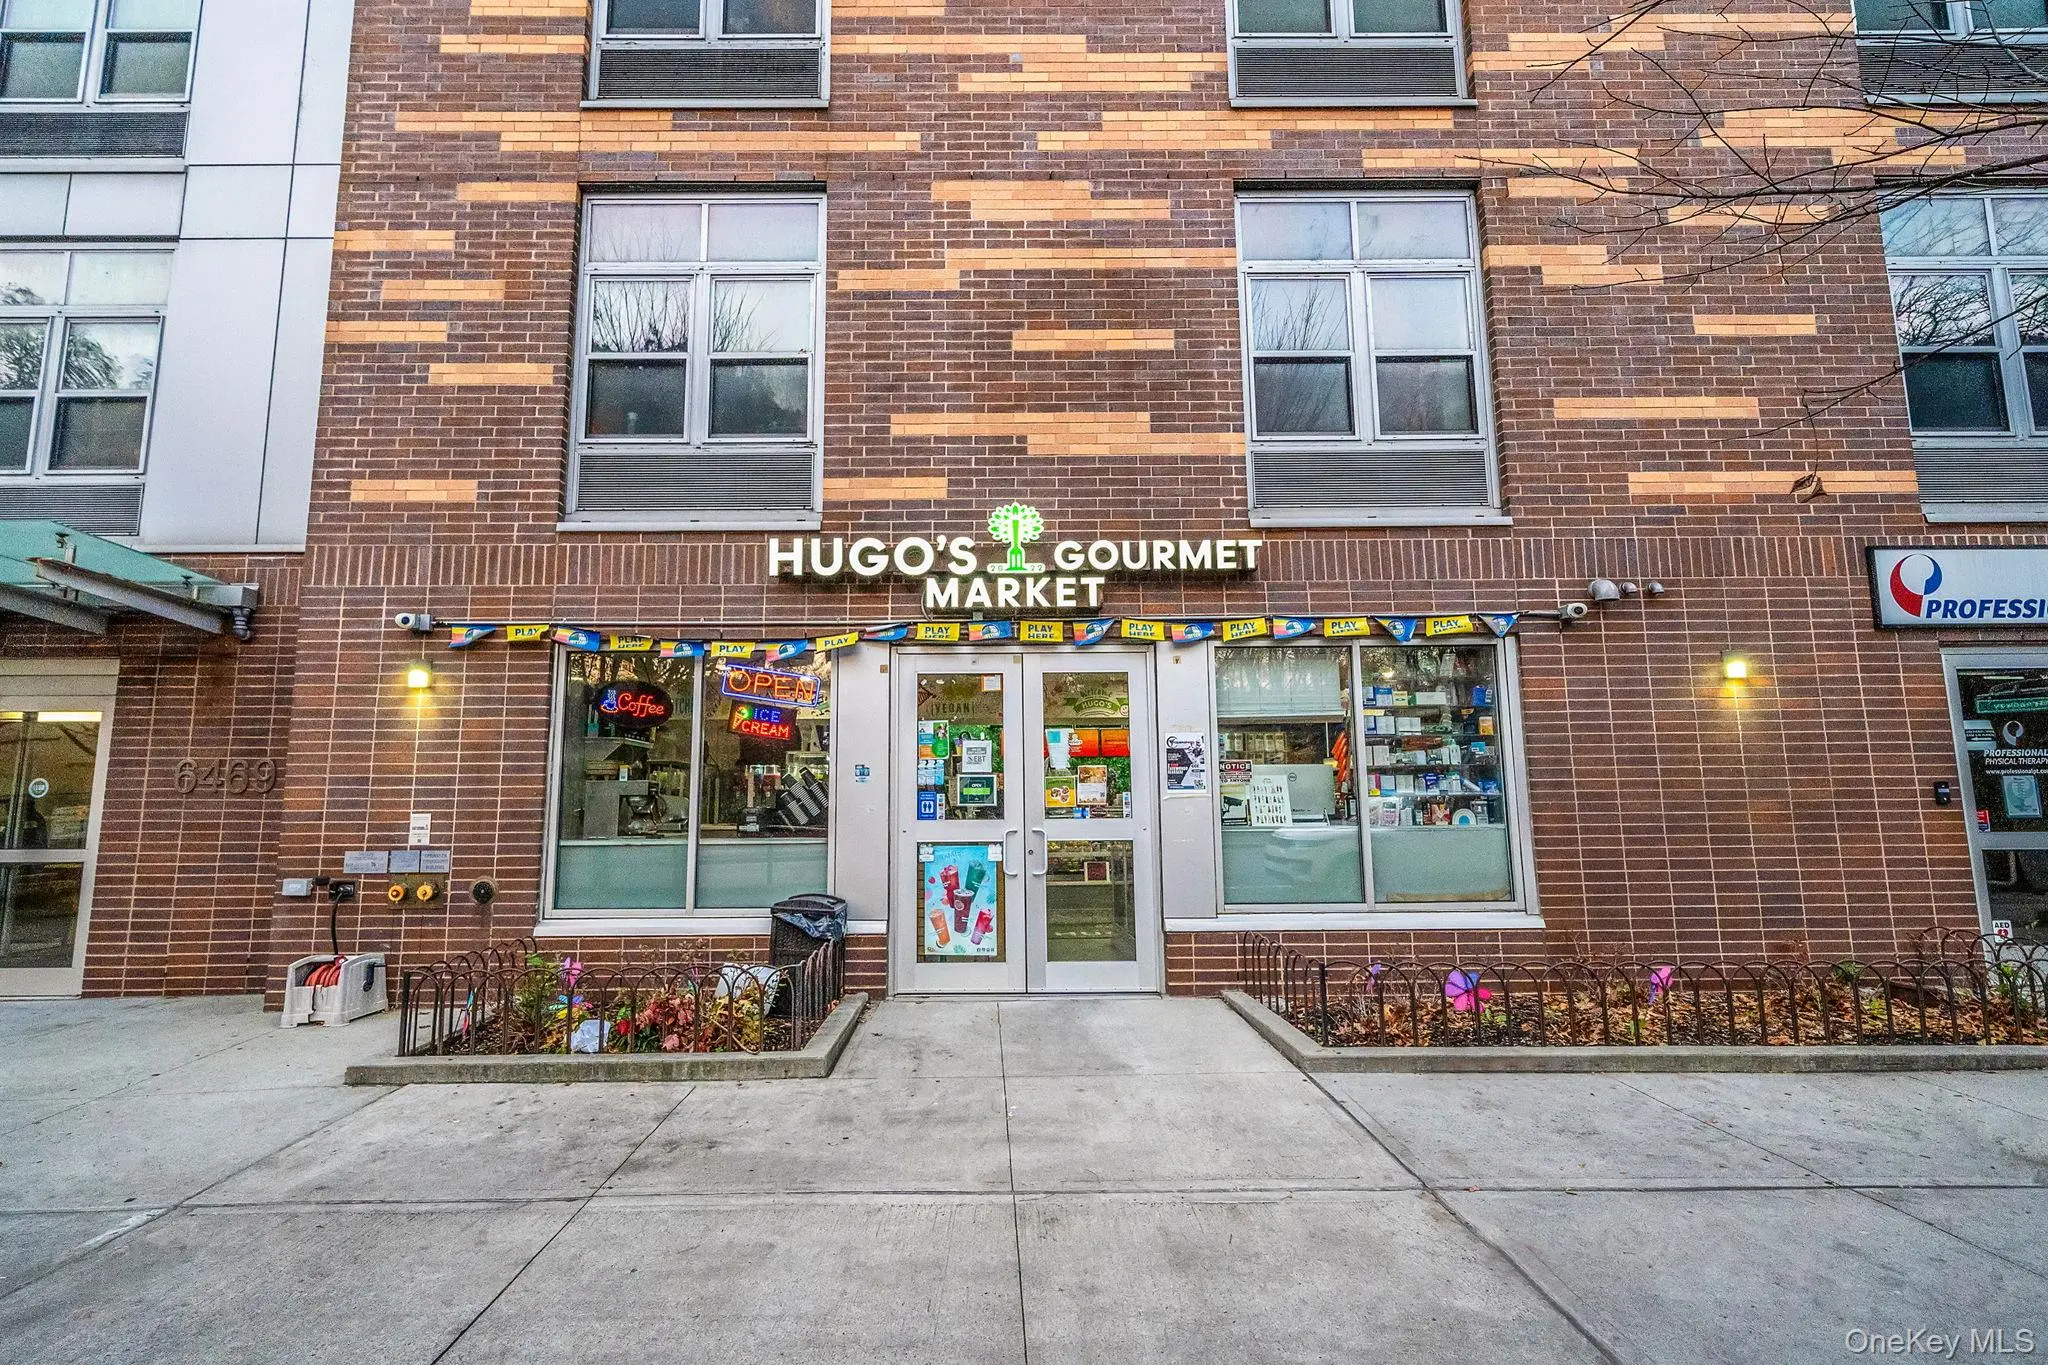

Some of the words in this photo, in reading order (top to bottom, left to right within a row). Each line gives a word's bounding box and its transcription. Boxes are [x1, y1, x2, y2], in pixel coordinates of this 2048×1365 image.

[768, 534, 978, 576] HUGO'S
[1053, 539, 1263, 571] GOURMET
[925, 577, 1106, 609] MARKET
[1925, 598, 2048, 619] PROFESSI
[1129, 623, 1154, 631] PLAY
[1230, 622, 1255, 631] PLAY
[1331, 621, 1357, 629] PLAY
[1433, 619, 1459, 628] PLAY
[515, 628, 540, 637] PLAY
[924, 626, 950, 634] PLAY
[1027, 624, 1053, 633] PLAY
[618, 635, 643, 644] PLAY
[824, 637, 850, 648] PLAY
[719, 645, 745, 653] PLAY
[728, 670, 815, 701] OPEN
[618, 692, 665, 718] Coffee
[1082, 700, 1112, 709] HUGO'S
[753, 708, 781, 723] ICE
[741, 720, 789, 738] CREAM
[1983, 748, 2048, 758] PROFESSIONAL
[1985, 757, 2018, 765] PHYSICAL
[173, 757, 278, 795] 6469
